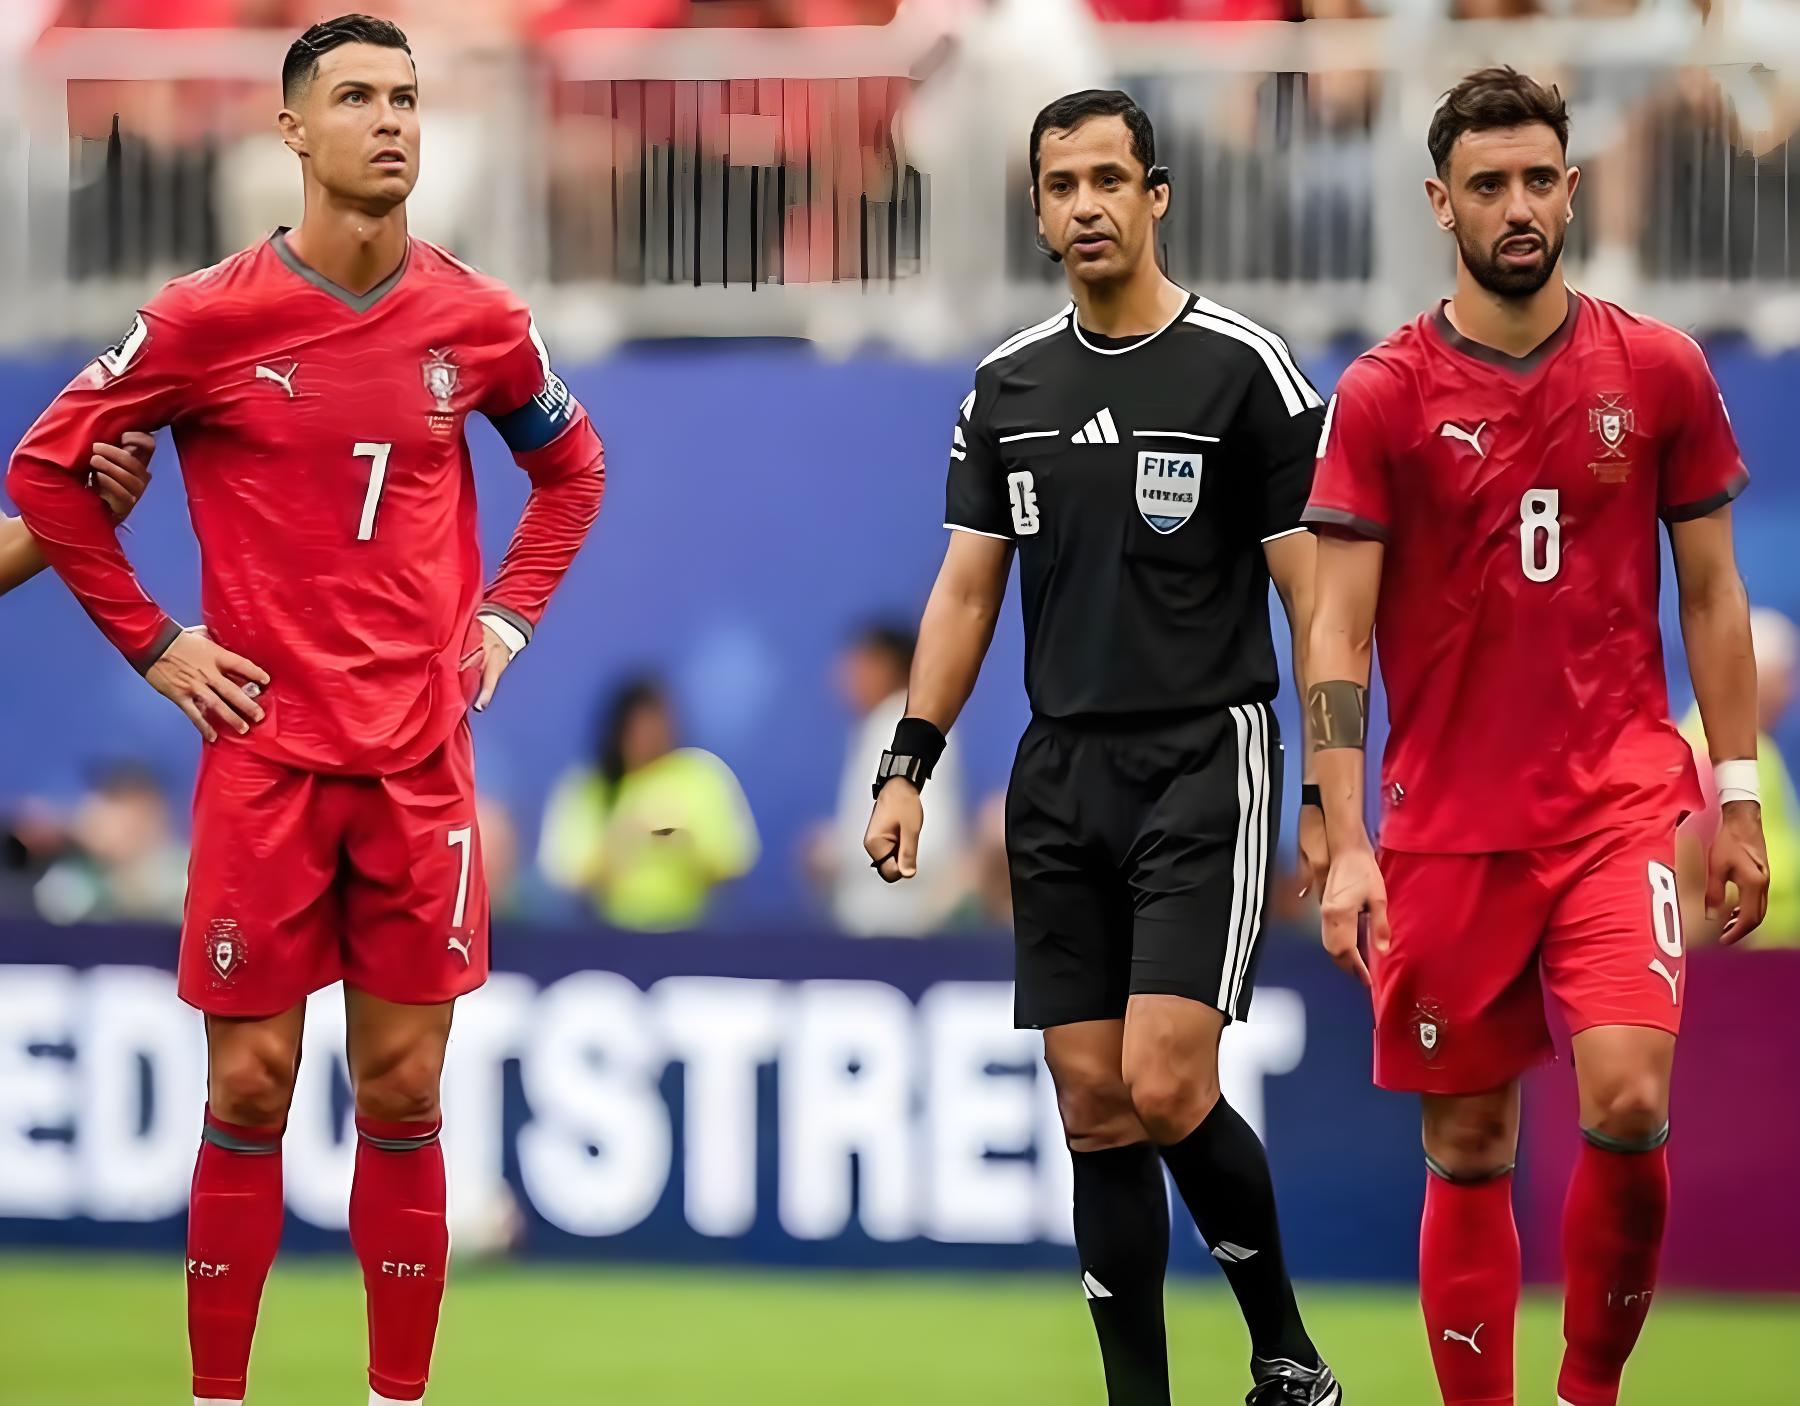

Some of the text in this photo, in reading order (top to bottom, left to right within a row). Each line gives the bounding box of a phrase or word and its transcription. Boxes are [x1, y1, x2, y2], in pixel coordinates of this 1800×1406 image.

[352, 441, 391, 541] 7
[1143, 456, 1195, 479] FIFA
[1519, 488, 1560, 583] 8
[447, 826, 471, 928] 7
[1647, 860, 1683, 958] 8
